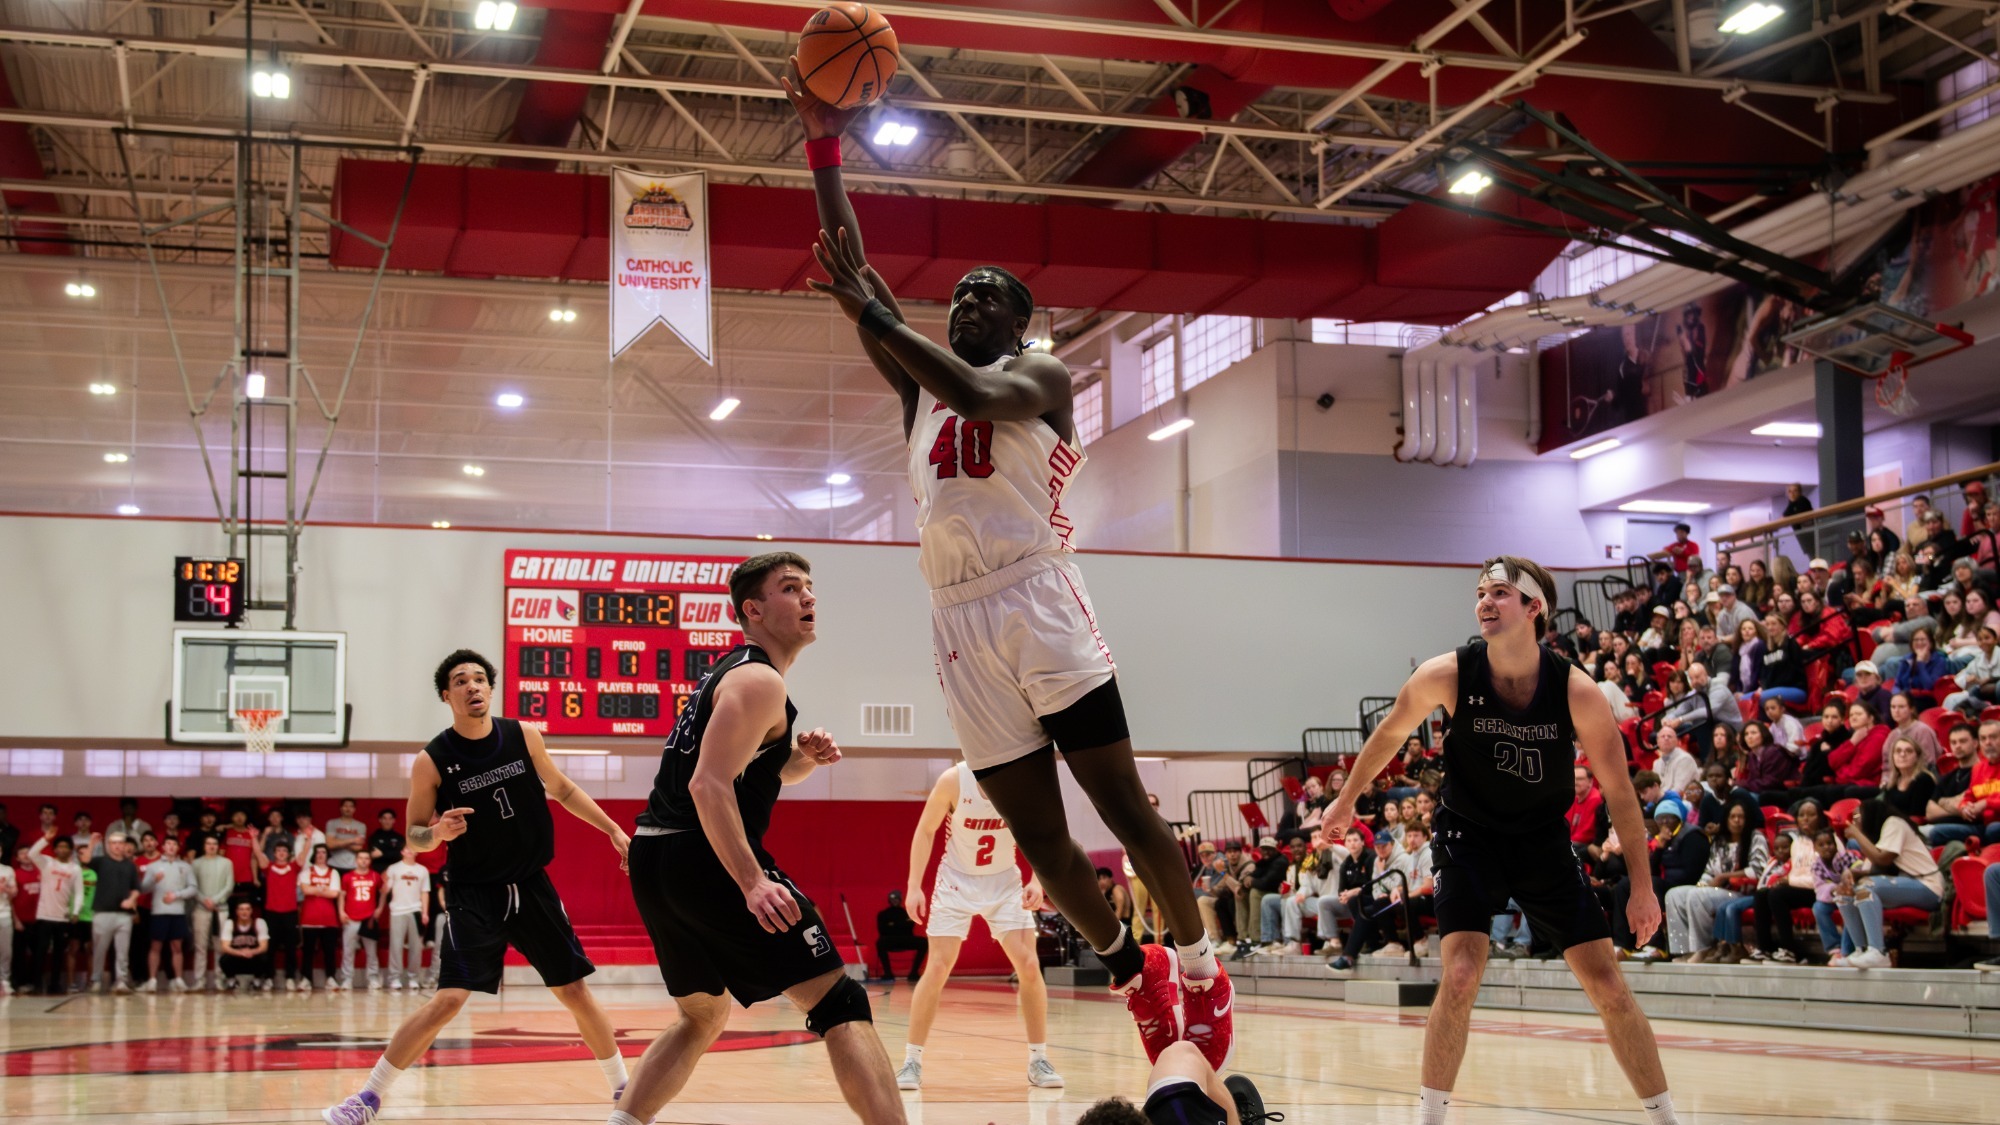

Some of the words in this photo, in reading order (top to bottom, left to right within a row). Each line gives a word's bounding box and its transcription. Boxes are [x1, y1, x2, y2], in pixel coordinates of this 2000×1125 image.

[626, 258, 693, 274] CATHOLIC
[618, 273, 702, 290] UNIVERSITY
[928, 415, 995, 480] 40
[510, 556, 616, 582] CATHOLIC
[206, 584, 230, 615] 4
[510, 598, 552, 618] CUA
[599, 595, 673, 625] 11:12
[681, 602, 723, 623] CUA
[523, 628, 573, 643] HOME
[612, 640, 646, 651] PERIOD
[689, 631, 732, 646] GUEST
[544, 650, 571, 675] 11
[631, 654, 637, 675] 1
[519, 681, 550, 692] FOULS
[560, 681, 586, 692] T.O.L.
[597, 682, 633, 693] PLAYER
[637, 683, 661, 694] FOUL
[671, 684, 693, 693] T.O.L
[530, 693, 545, 716] 2
[565, 693, 581, 718] 6
[613, 722, 644, 733] MATCH
[1473, 718, 1559, 741] SCRANTON
[1494, 741, 1543, 783] 20
[458, 760, 526, 795] SCRANTON
[493, 787, 515, 819] 1
[976, 835, 996, 866] 2
[355, 887, 371, 901] 15
[802, 924, 831, 958] S
